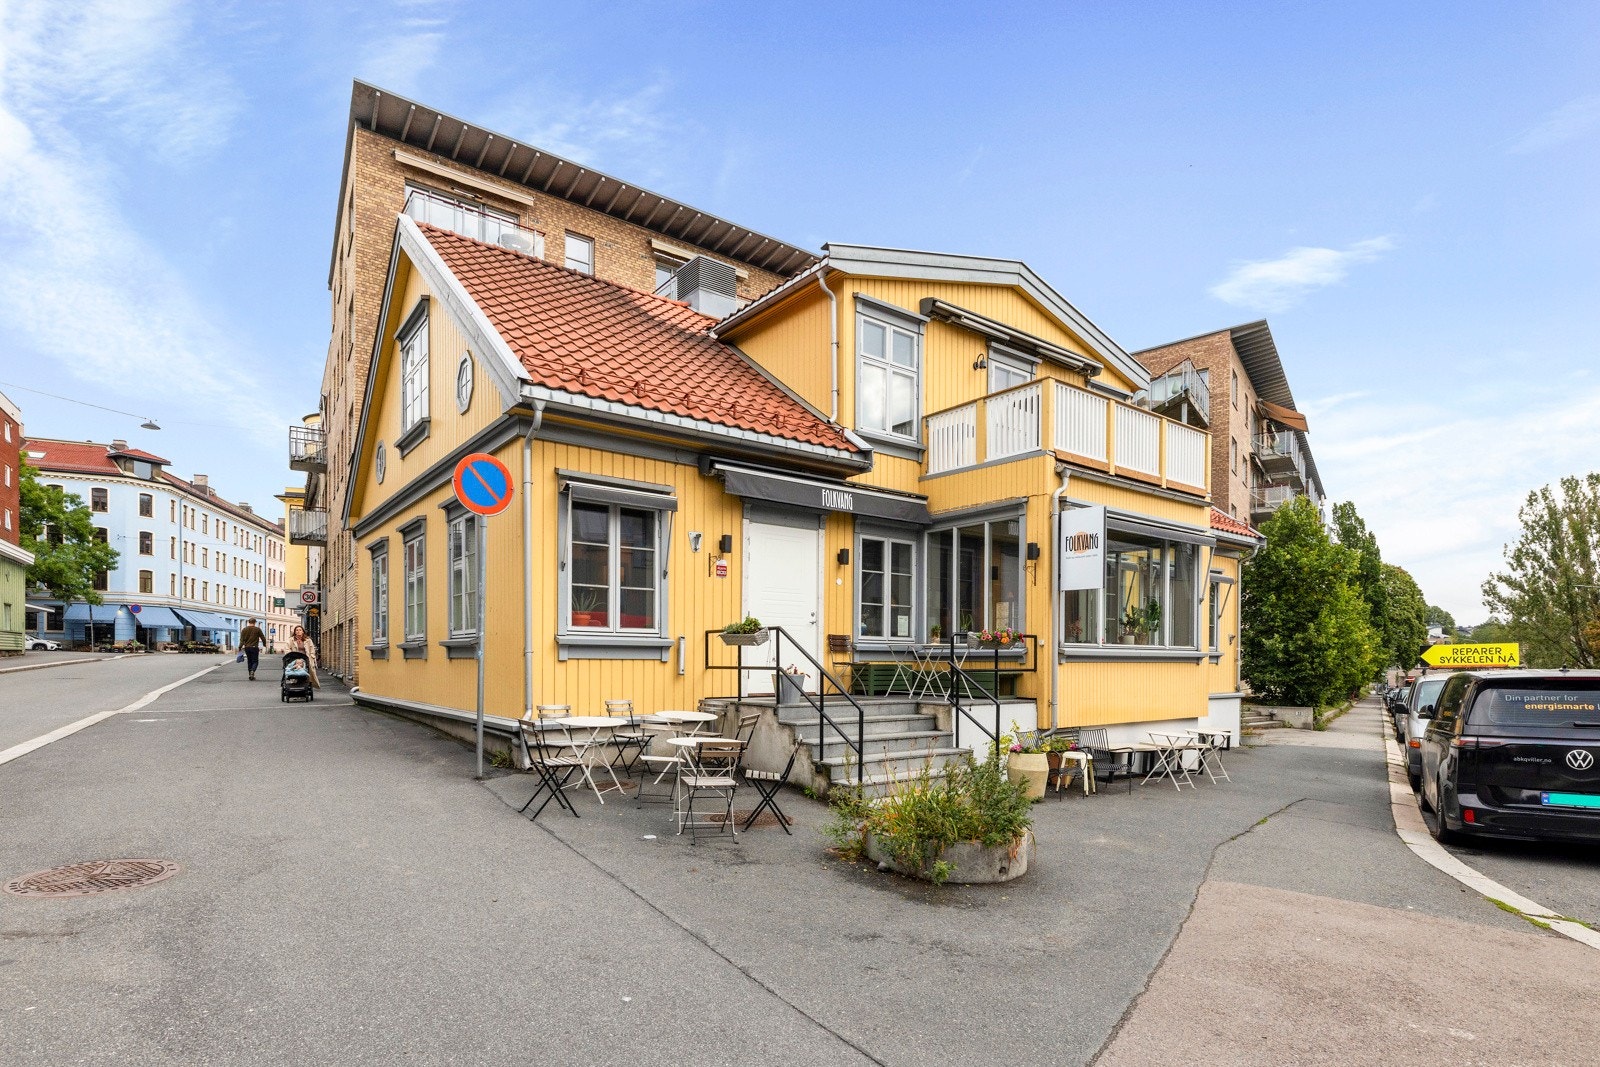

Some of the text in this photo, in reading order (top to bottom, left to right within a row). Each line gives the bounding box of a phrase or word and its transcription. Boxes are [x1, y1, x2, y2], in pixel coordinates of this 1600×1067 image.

[821, 488, 853, 510] FOLKVANG
[1065, 532, 1099, 552] FOLKVANG
[304, 593, 314, 601] 30
[1452, 647, 1502, 656] REPARER
[1439, 653, 1516, 664] SYKKELEN NÅ
[1504, 694, 1579, 703] Din partner for
[1524, 702, 1595, 711] energismarte
[1513, 756, 1552, 764] abkqviller.no
